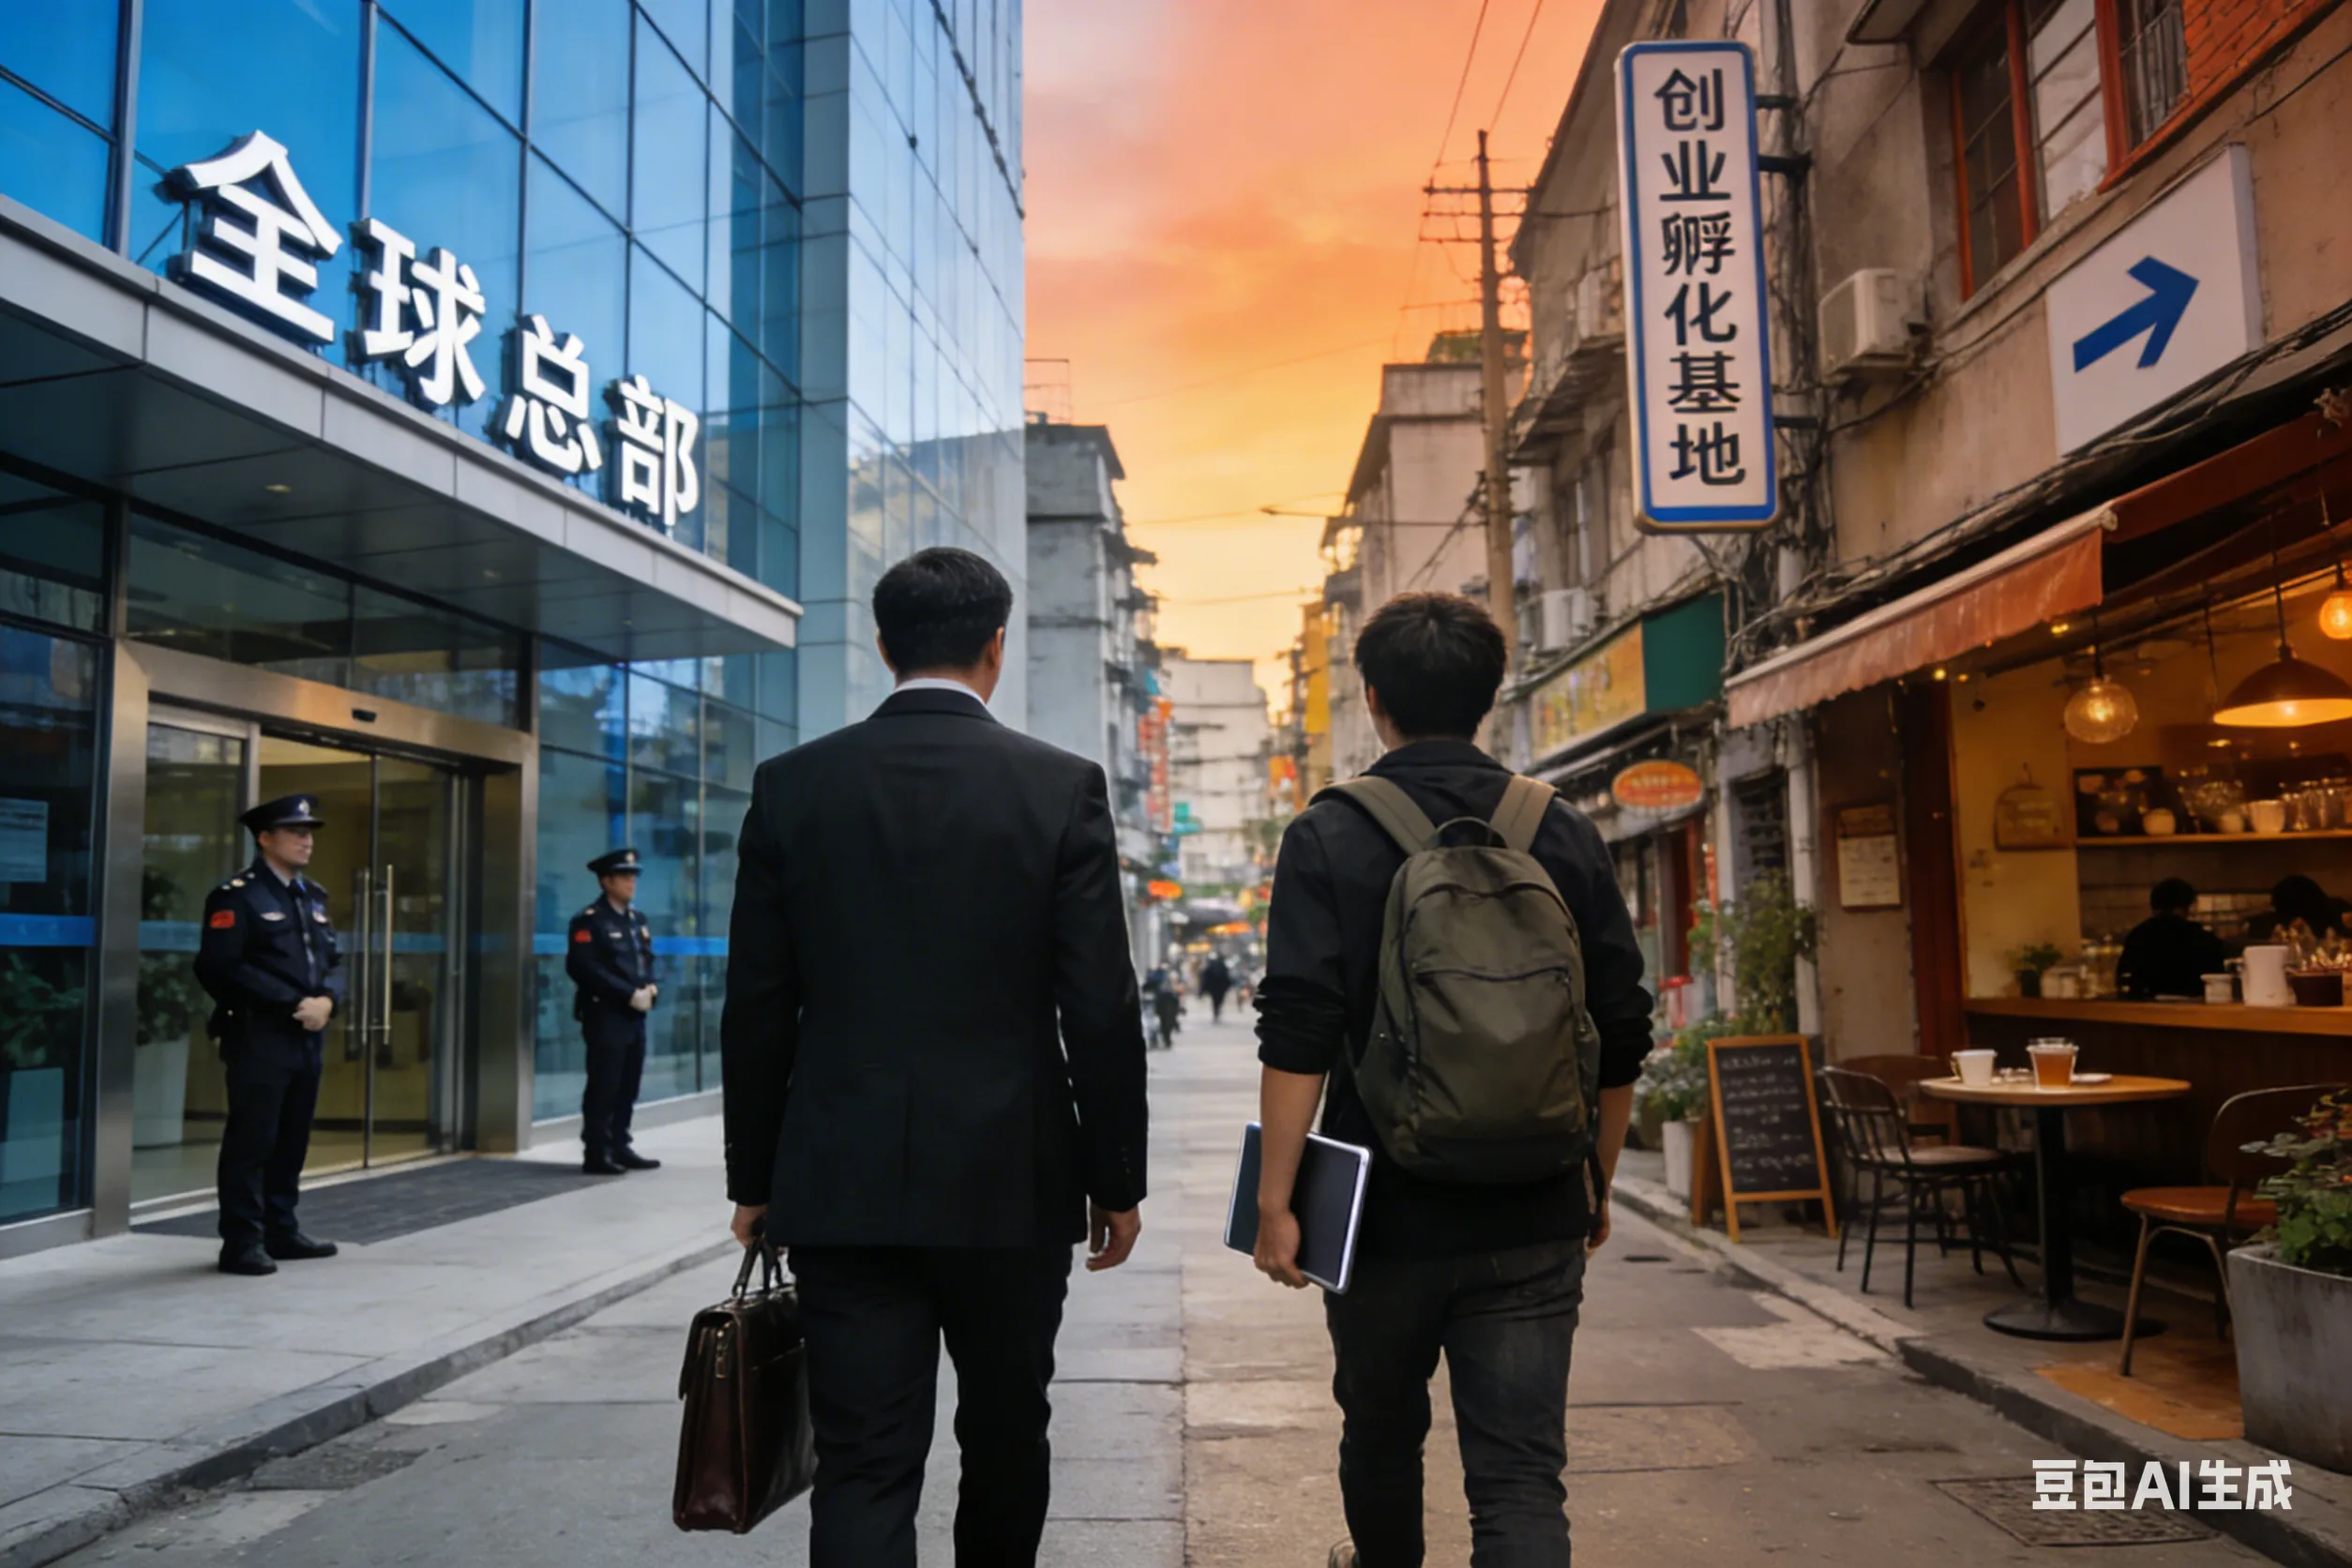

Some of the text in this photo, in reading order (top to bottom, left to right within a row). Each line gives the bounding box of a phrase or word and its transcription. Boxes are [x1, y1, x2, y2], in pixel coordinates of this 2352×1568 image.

[180, 128, 701, 528] 全球总部
[1653, 68, 1746, 487] 创业孵化基地
